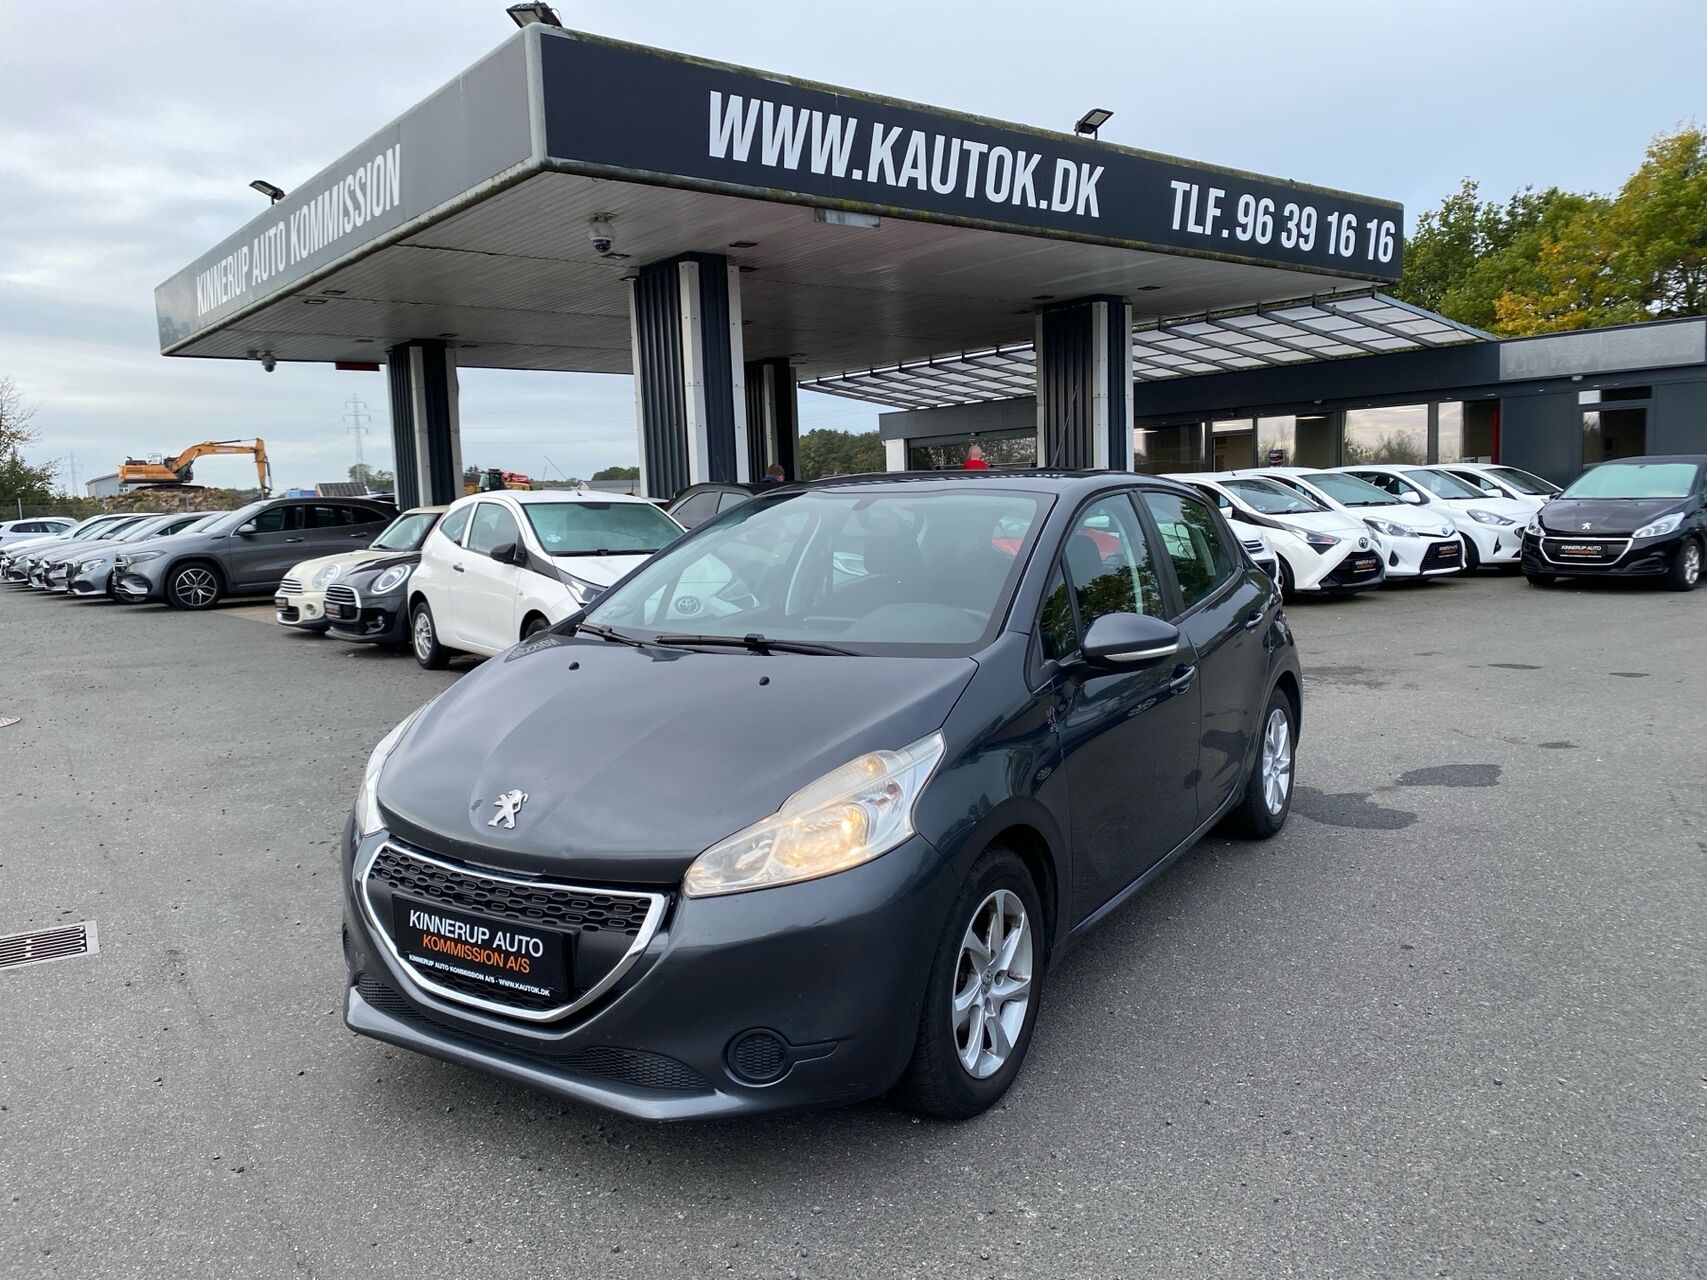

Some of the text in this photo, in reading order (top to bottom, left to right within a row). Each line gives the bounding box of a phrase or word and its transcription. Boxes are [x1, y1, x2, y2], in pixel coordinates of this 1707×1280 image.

[709, 90, 1105, 218] WWW.KAUTOK.DK
[196, 143, 400, 316] KINNERUP AUTO KOMMISSION
[1170, 180, 1396, 263] TLF. 96 39 16 16
[409, 909, 544, 958] KINNERUP AUTO
[422, 934, 530, 973] KOMMISSION A/S
[408, 953, 435, 967] KINNERUP
[435, 962, 449, 971] AUTO
[485, 975, 495, 984] A/S
